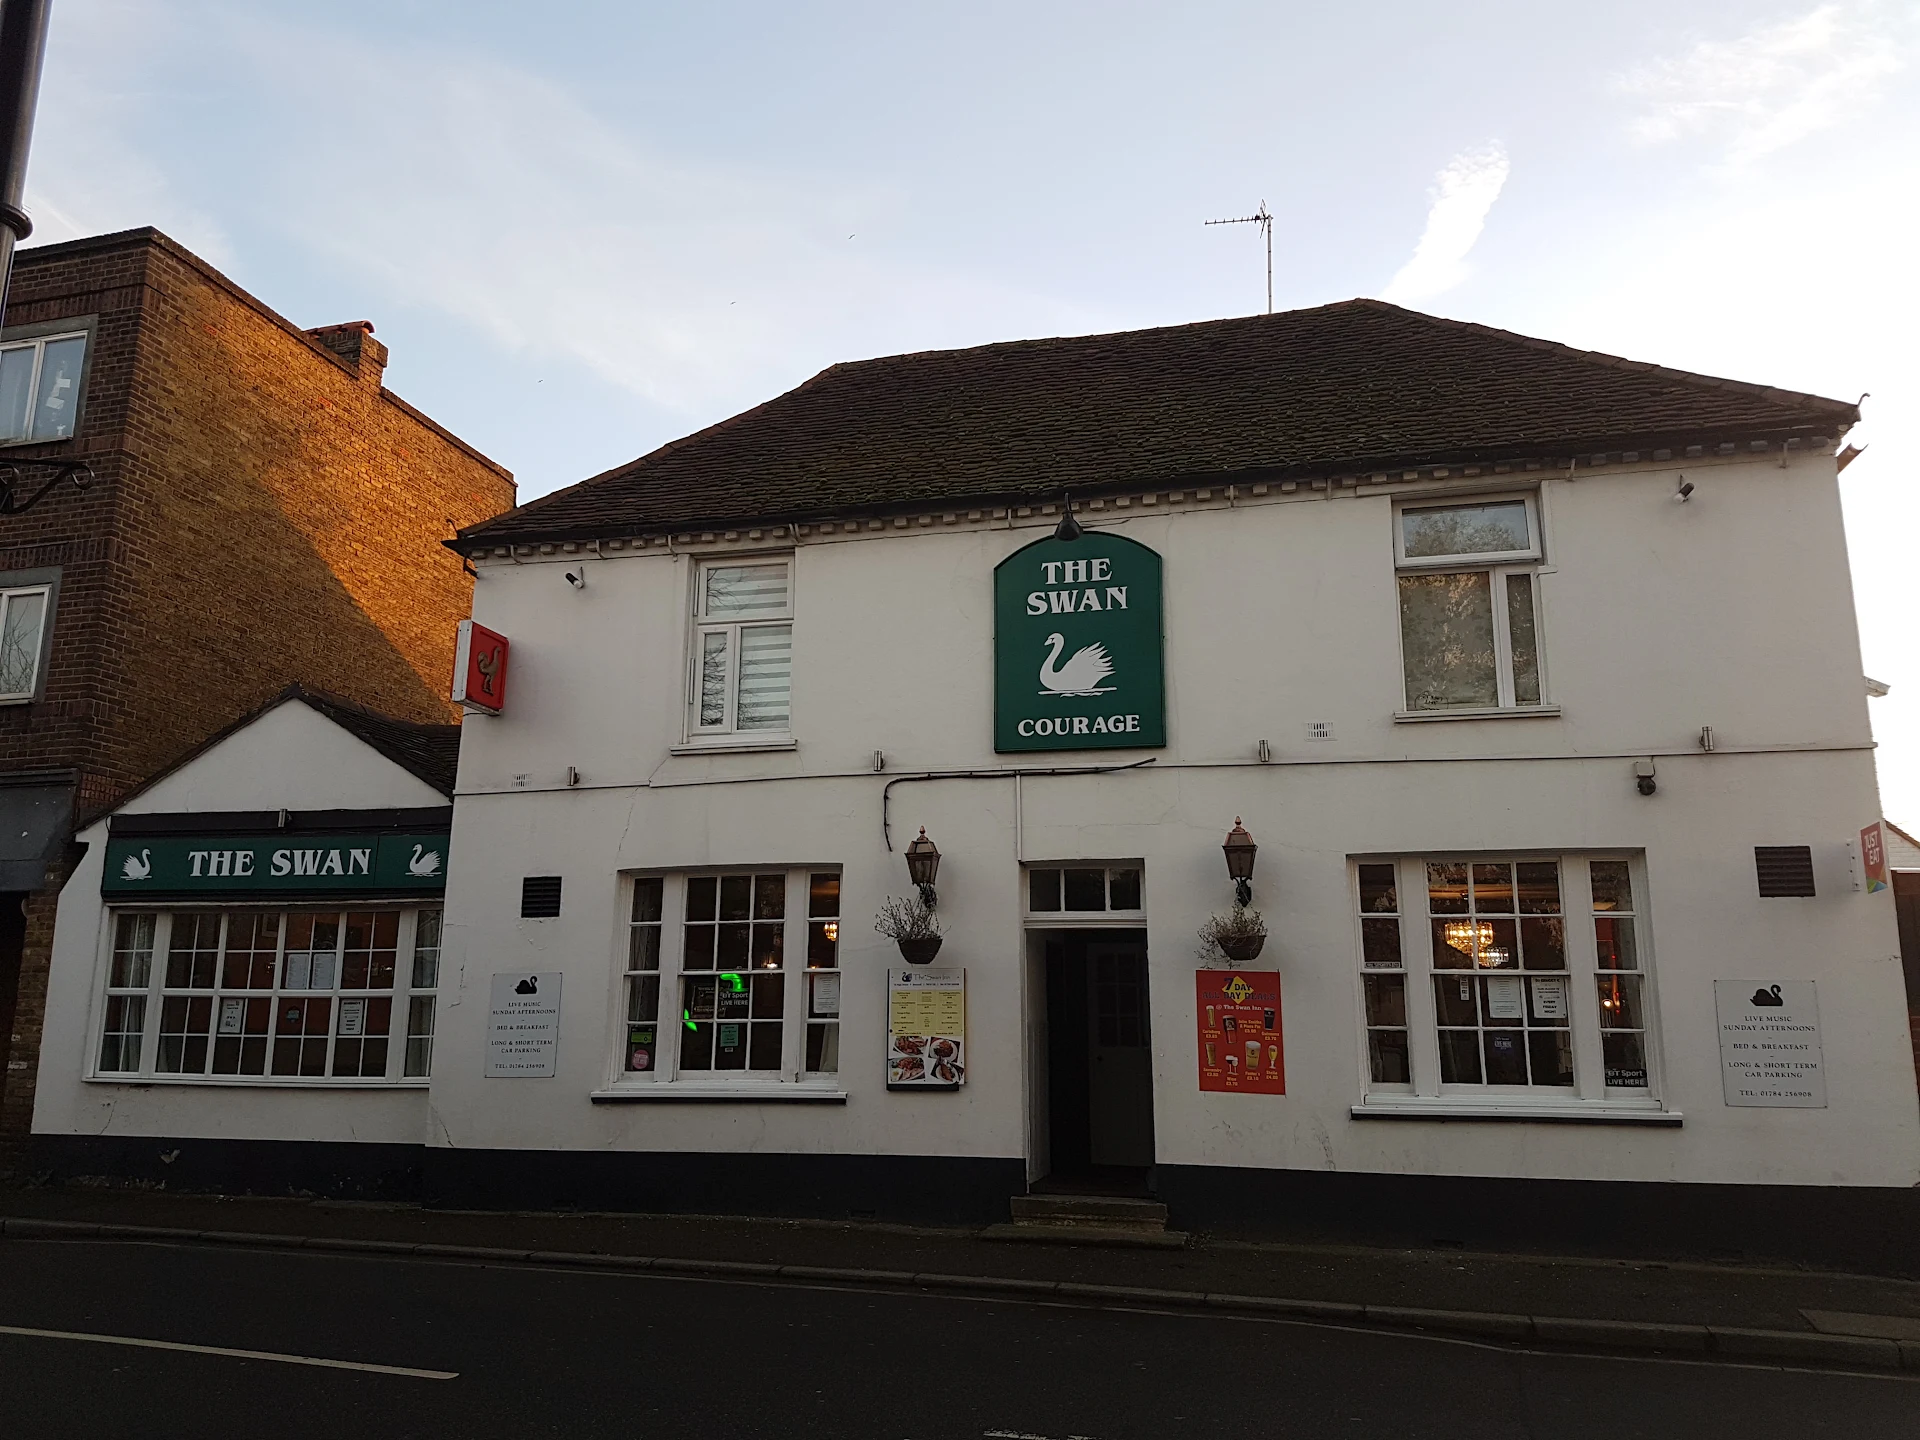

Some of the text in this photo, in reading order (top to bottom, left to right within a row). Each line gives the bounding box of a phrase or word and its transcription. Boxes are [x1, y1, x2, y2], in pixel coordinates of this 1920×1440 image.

[1040, 557, 1113, 585] THE
[1026, 585, 1128, 616] SWAN
[1017, 714, 1140, 737] COURAGE
[1864, 830, 1878, 853] JUST
[187, 848, 372, 877] THE SWAN
[1869, 846, 1880, 866] EAT
[1224, 977, 1251, 991] 7 DAY
[1223, 992, 1241, 1000] DAY
[1761, 1043, 1810, 1051] BREAKFAST
[1607, 1069, 1643, 1077] BT Sport
[1624, 1078, 1645, 1086] HERE
[1739, 1089, 1758, 1097] TEL:
